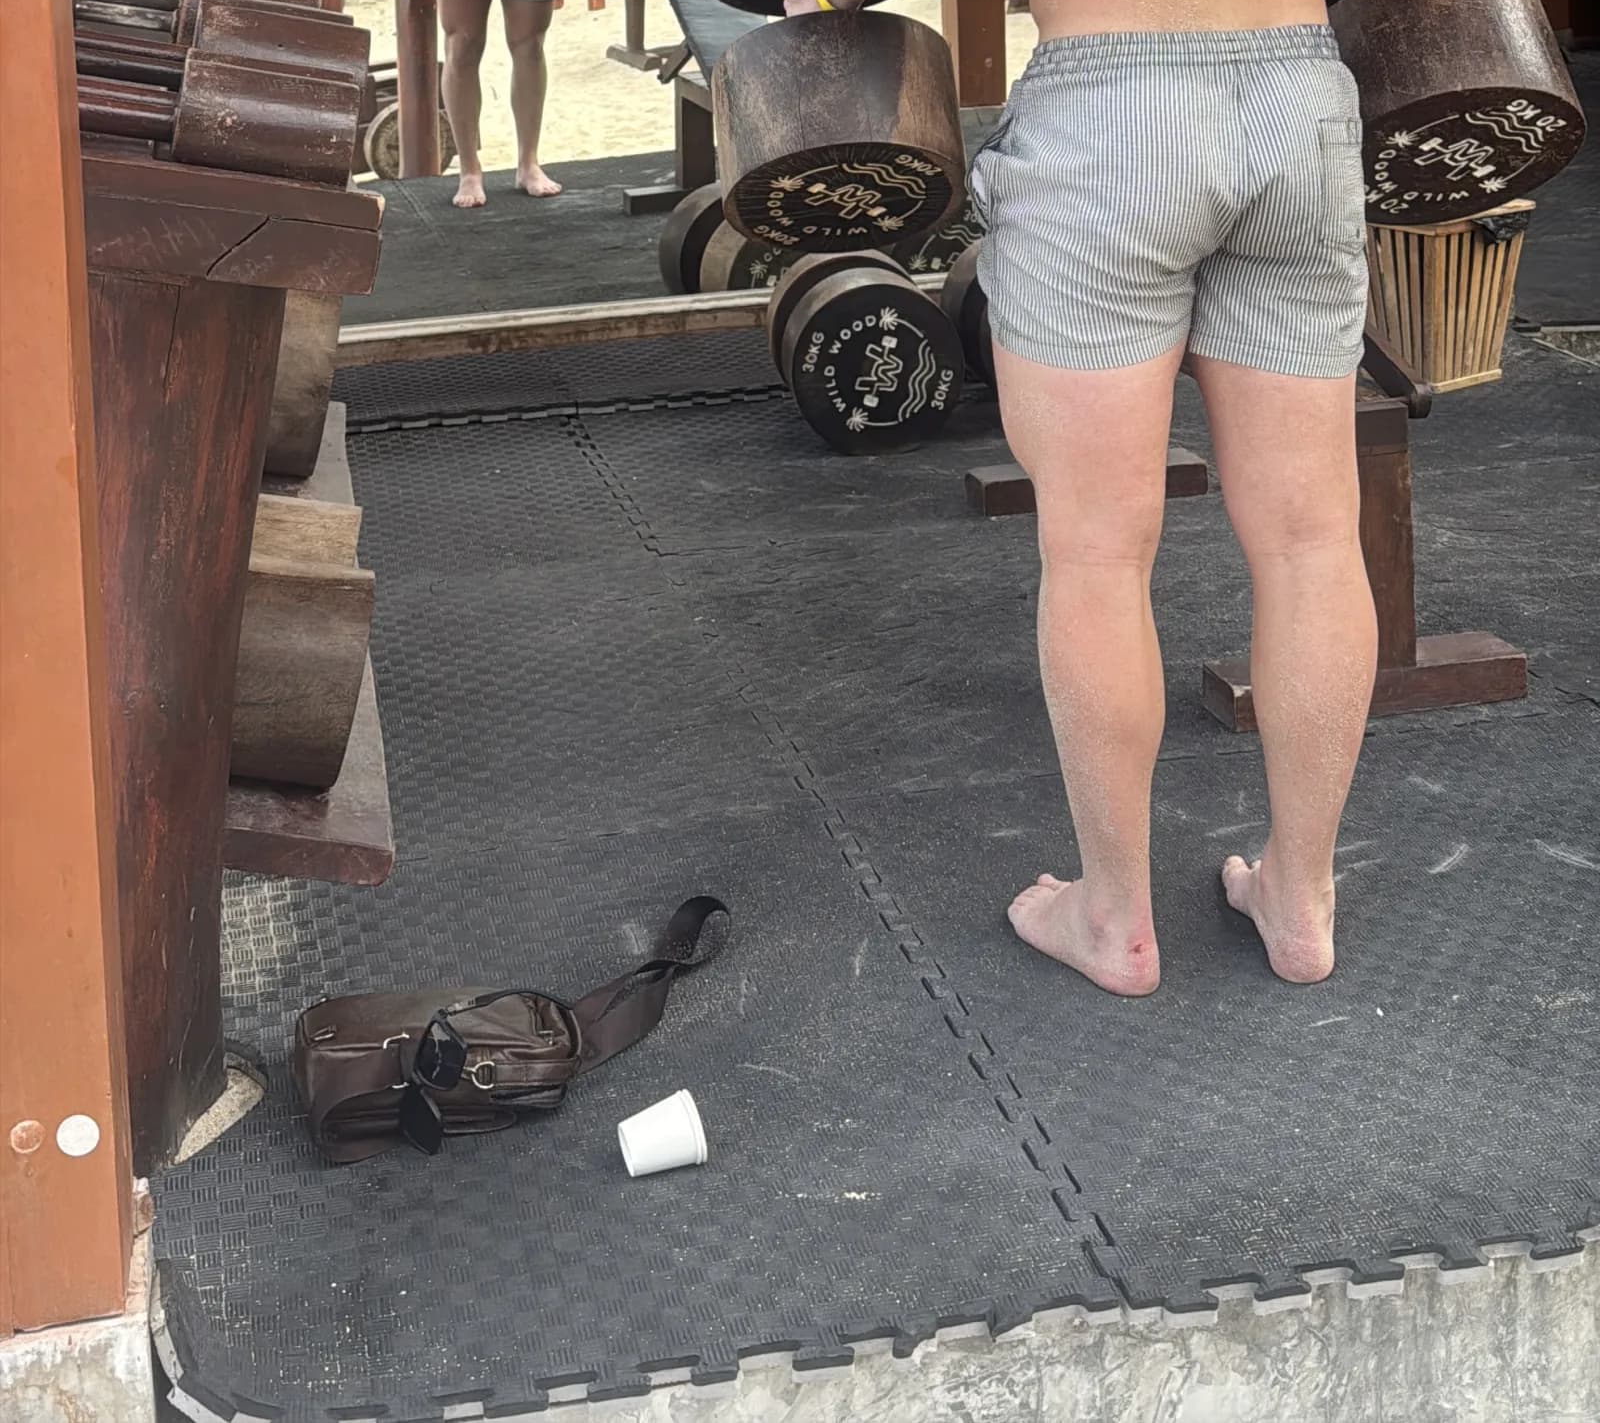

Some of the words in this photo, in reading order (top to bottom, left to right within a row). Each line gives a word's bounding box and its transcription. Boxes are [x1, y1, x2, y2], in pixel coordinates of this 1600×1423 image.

[1374, 149, 1399, 193] WOOD
[767, 191, 794, 227] WOOD
[1403, 190, 1470, 203] WILD
[802, 225, 868, 237] WILD
[802, 331, 824, 373] 30KG
[828, 315, 877, 354] WOOD
[824, 365, 847, 412] WILD
[930, 369, 954, 410] 30KG
